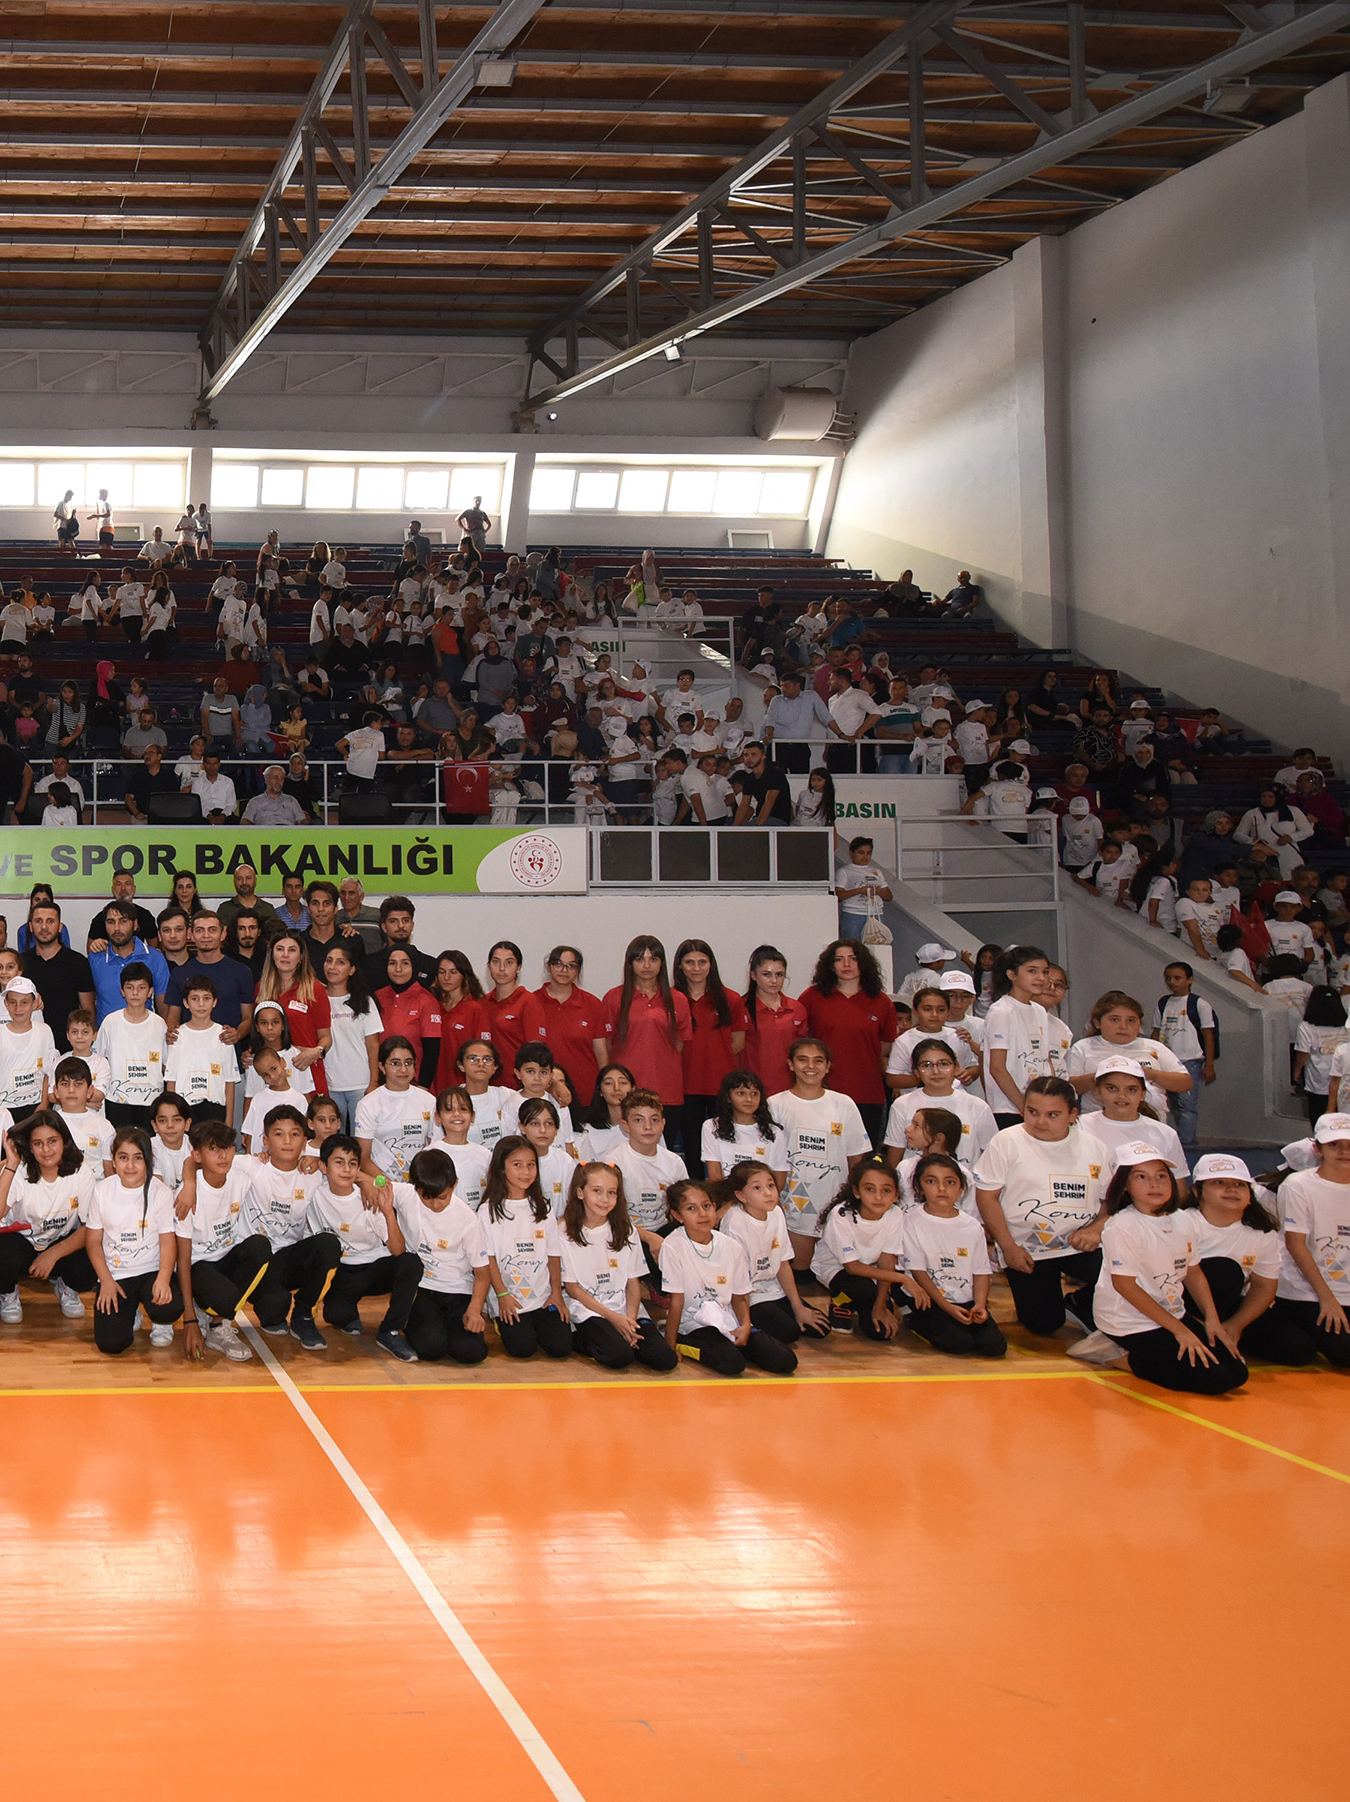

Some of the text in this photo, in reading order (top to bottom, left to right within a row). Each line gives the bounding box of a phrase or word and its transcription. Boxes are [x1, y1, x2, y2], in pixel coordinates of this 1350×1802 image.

[51, 844, 178, 876] SPOR
[195, 837, 454, 876] BAKANLIĞI
[1053, 1182, 1086, 1192] BENİM
[1053, 1191, 1086, 1200] ŞEHRİM
